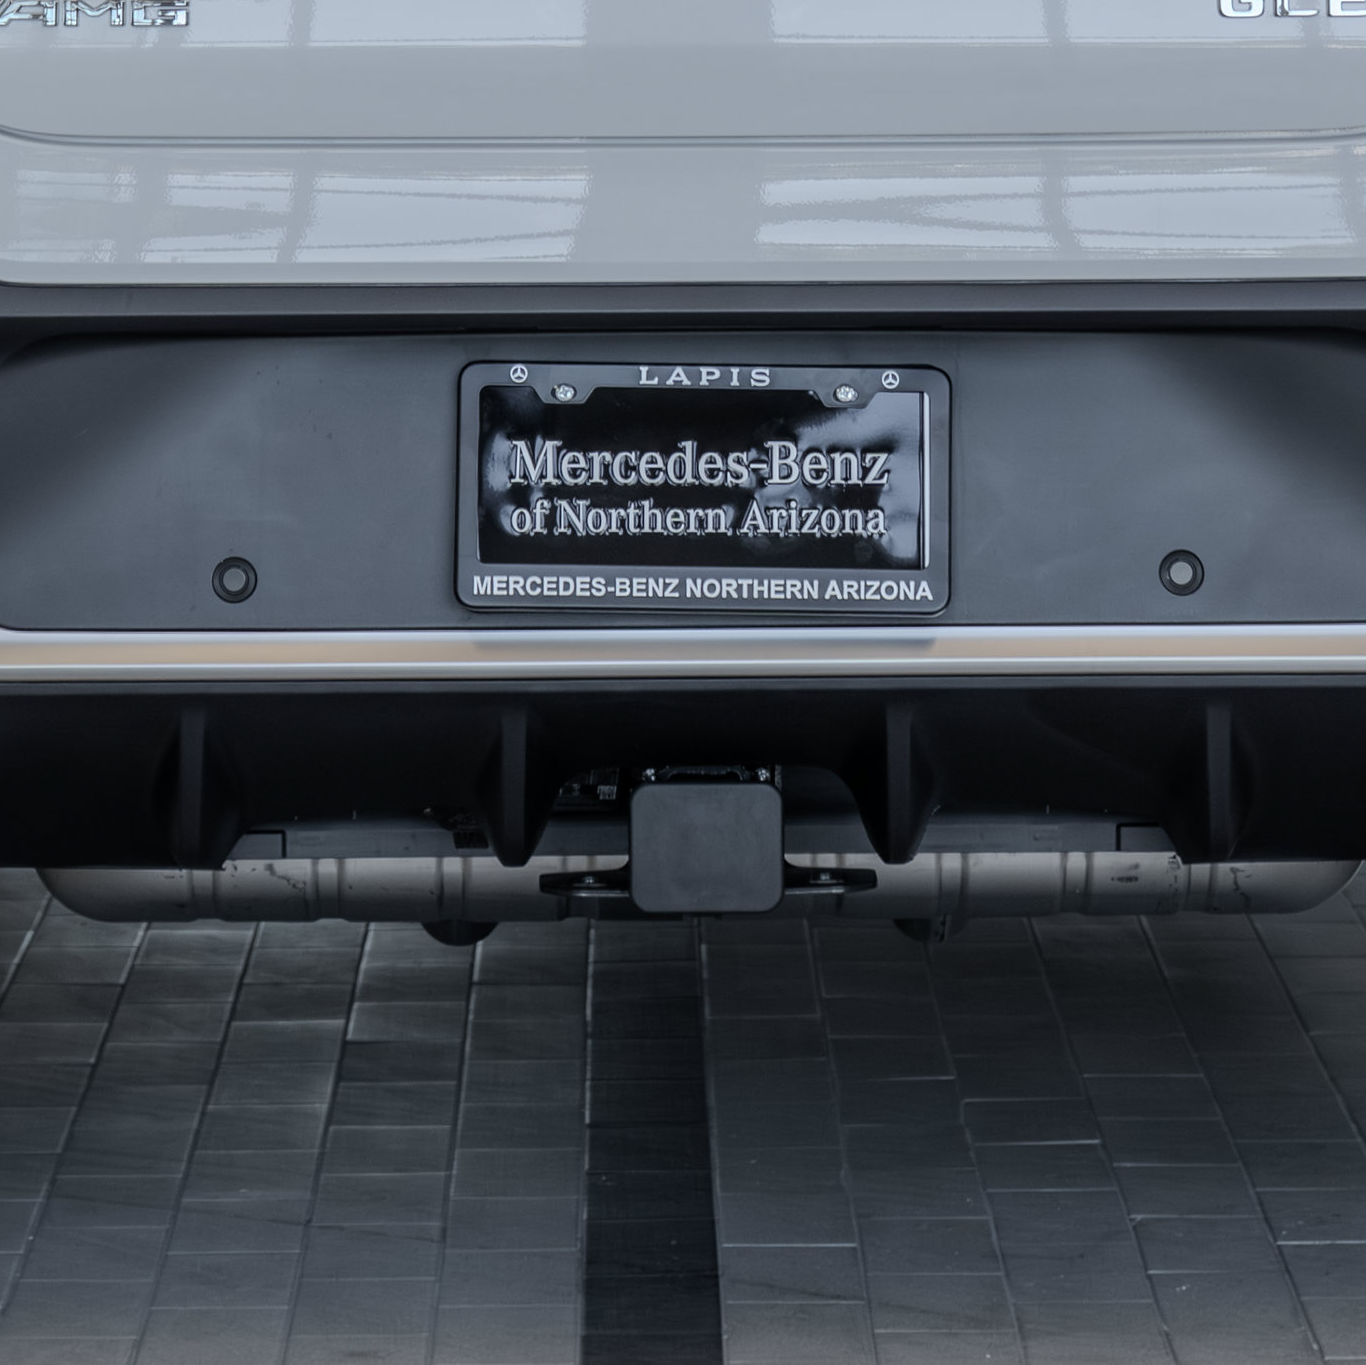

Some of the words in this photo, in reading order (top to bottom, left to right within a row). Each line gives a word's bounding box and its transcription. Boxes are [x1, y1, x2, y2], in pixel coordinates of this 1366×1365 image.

[639, 366, 771, 387] LAPIS
[509, 440, 890, 487] Mercedes-Benz
[510, 500, 550, 534] of
[556, 499, 731, 536] Northern
[740, 501, 886, 536] Arizona
[473, 574, 680, 599] MERCEDES-BENZ
[685, 578, 819, 600] NORTHERN
[824, 580, 934, 601] ARIZONA
